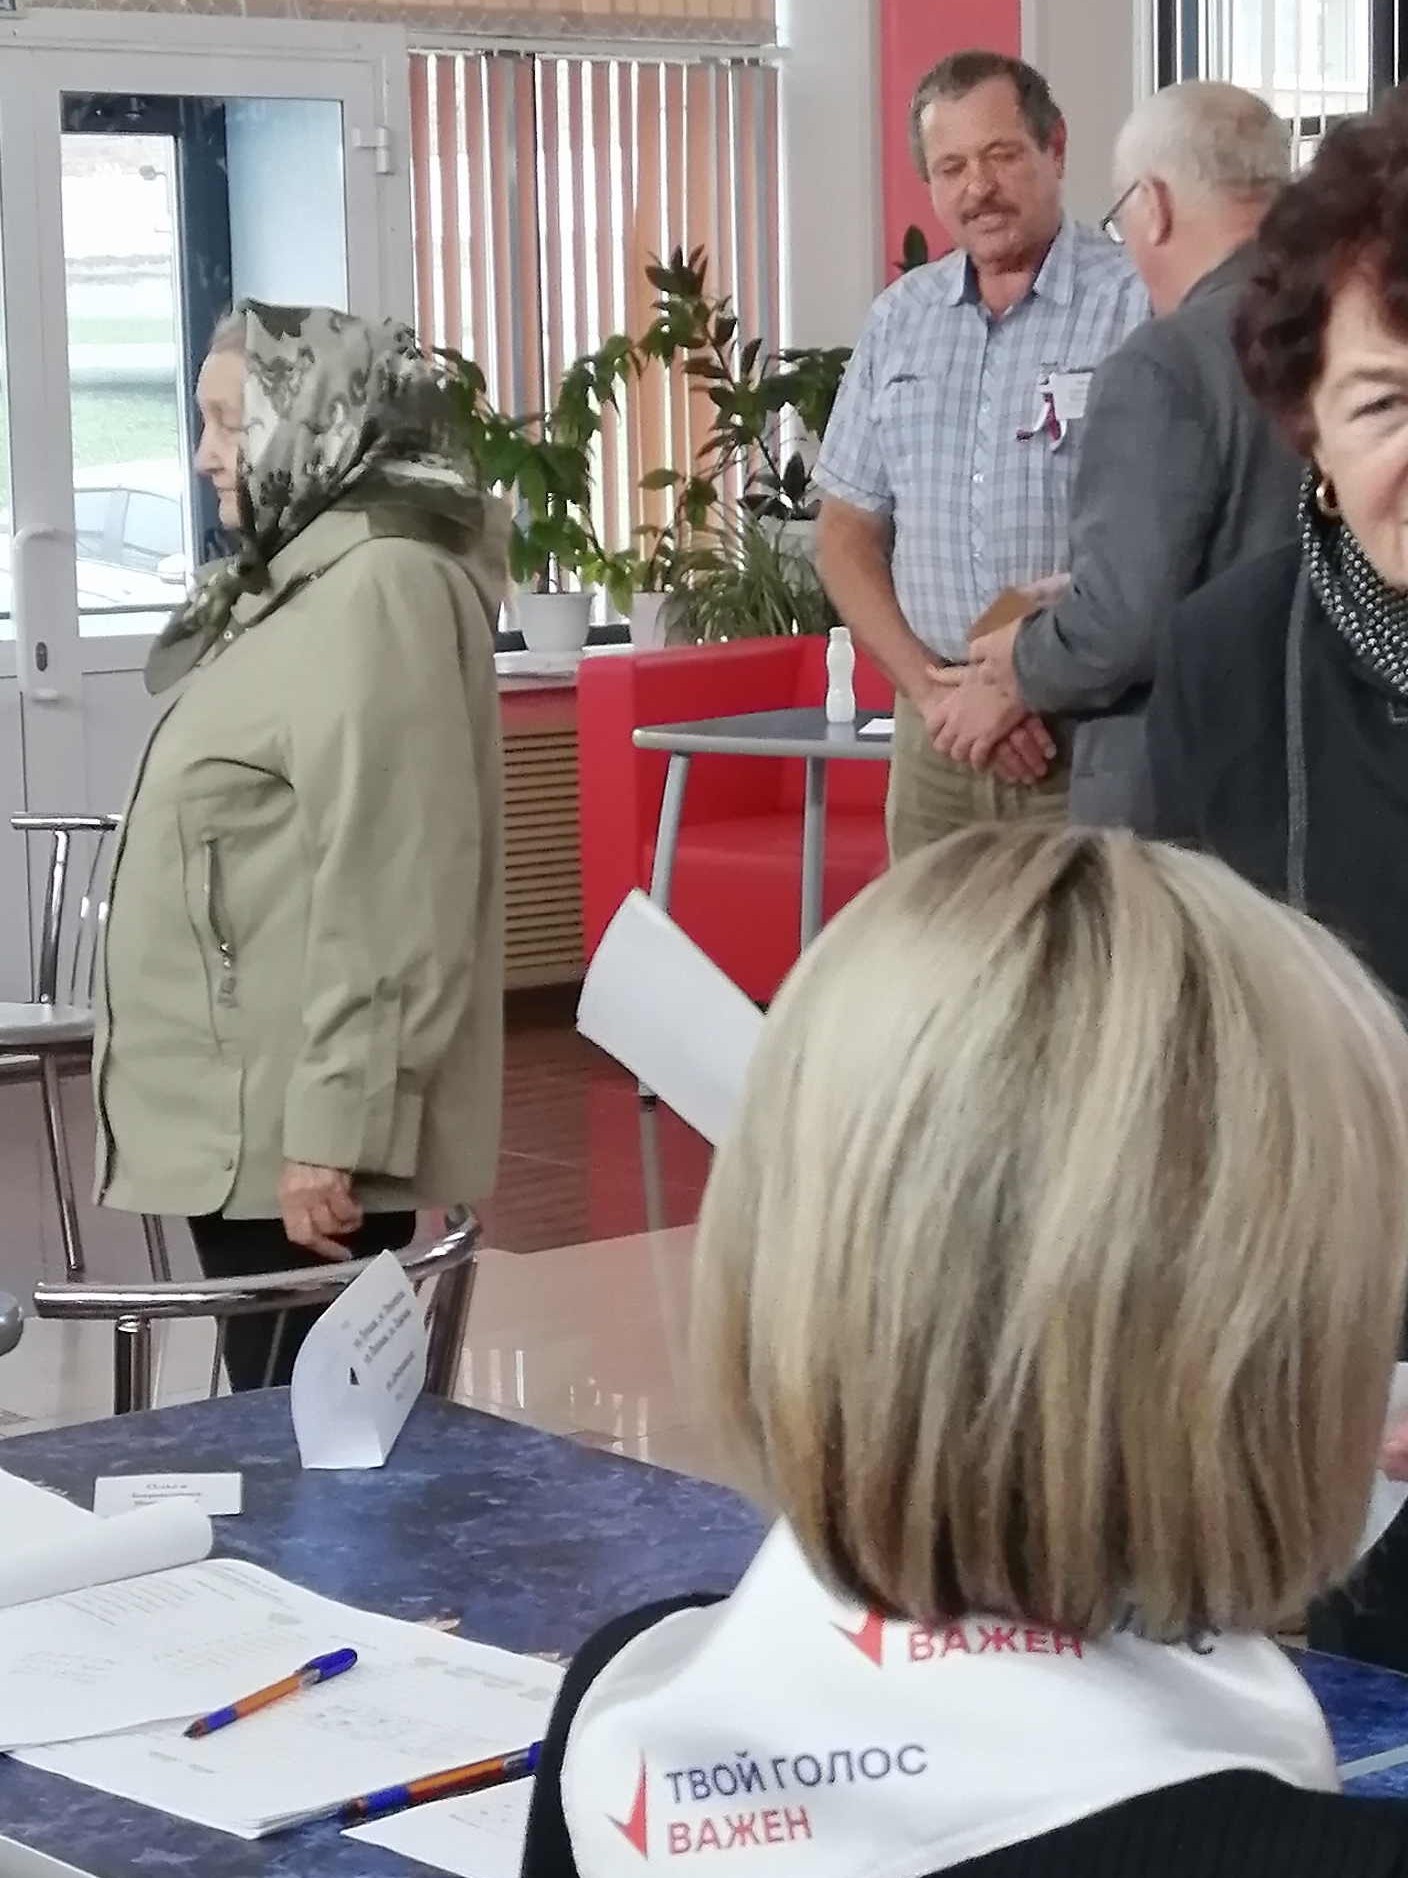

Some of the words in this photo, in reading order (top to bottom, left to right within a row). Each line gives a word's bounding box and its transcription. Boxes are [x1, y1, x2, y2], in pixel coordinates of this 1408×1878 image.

[910, 1625, 1082, 1662] ВАЖЕН
[665, 1750, 766, 1803] ТВОЙ
[771, 1744, 927, 1790] ГОЛОС
[667, 1805, 813, 1856] ВАЖЕН
